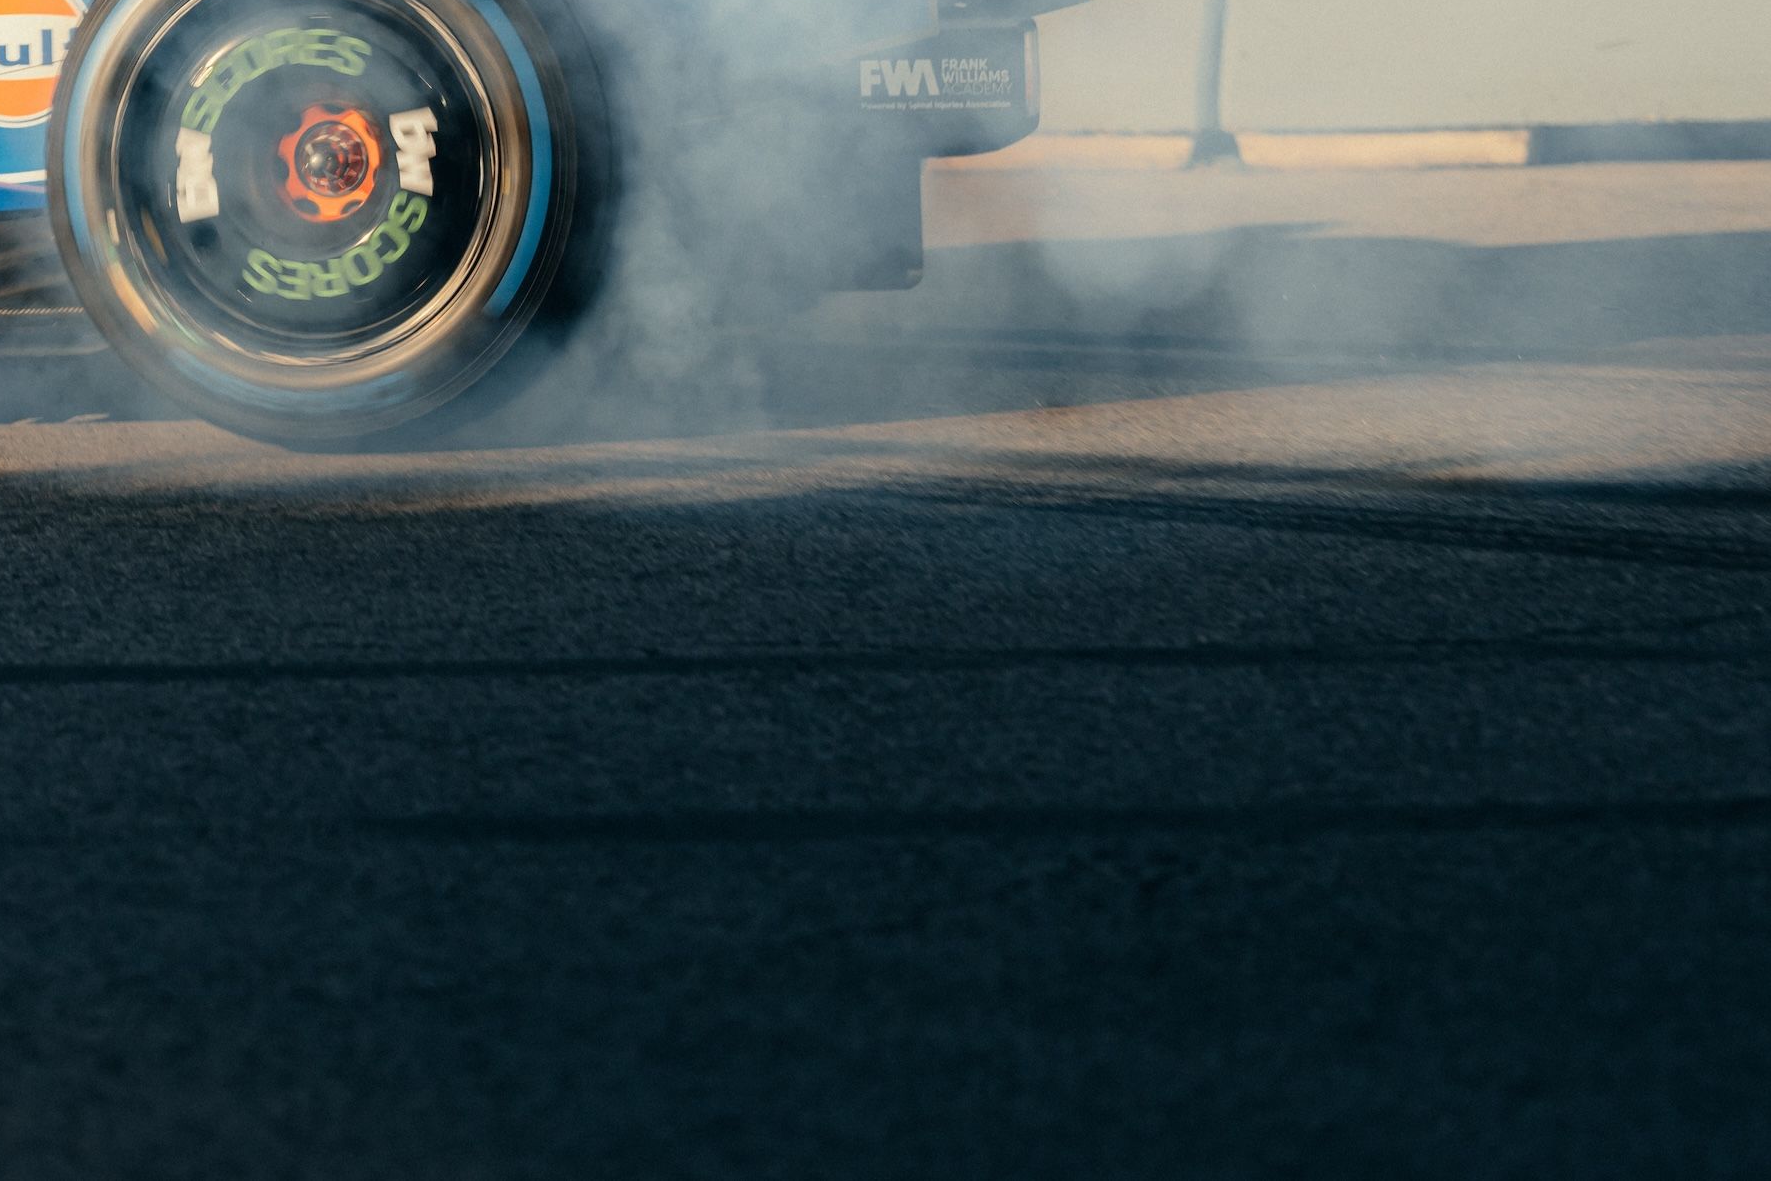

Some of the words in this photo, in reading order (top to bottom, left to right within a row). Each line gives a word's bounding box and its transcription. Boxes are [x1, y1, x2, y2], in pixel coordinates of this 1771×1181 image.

[941, 58, 989, 70] FRANK
[941, 69, 1010, 84] WILLIAMS
[941, 82, 1013, 95] ACADEMY
